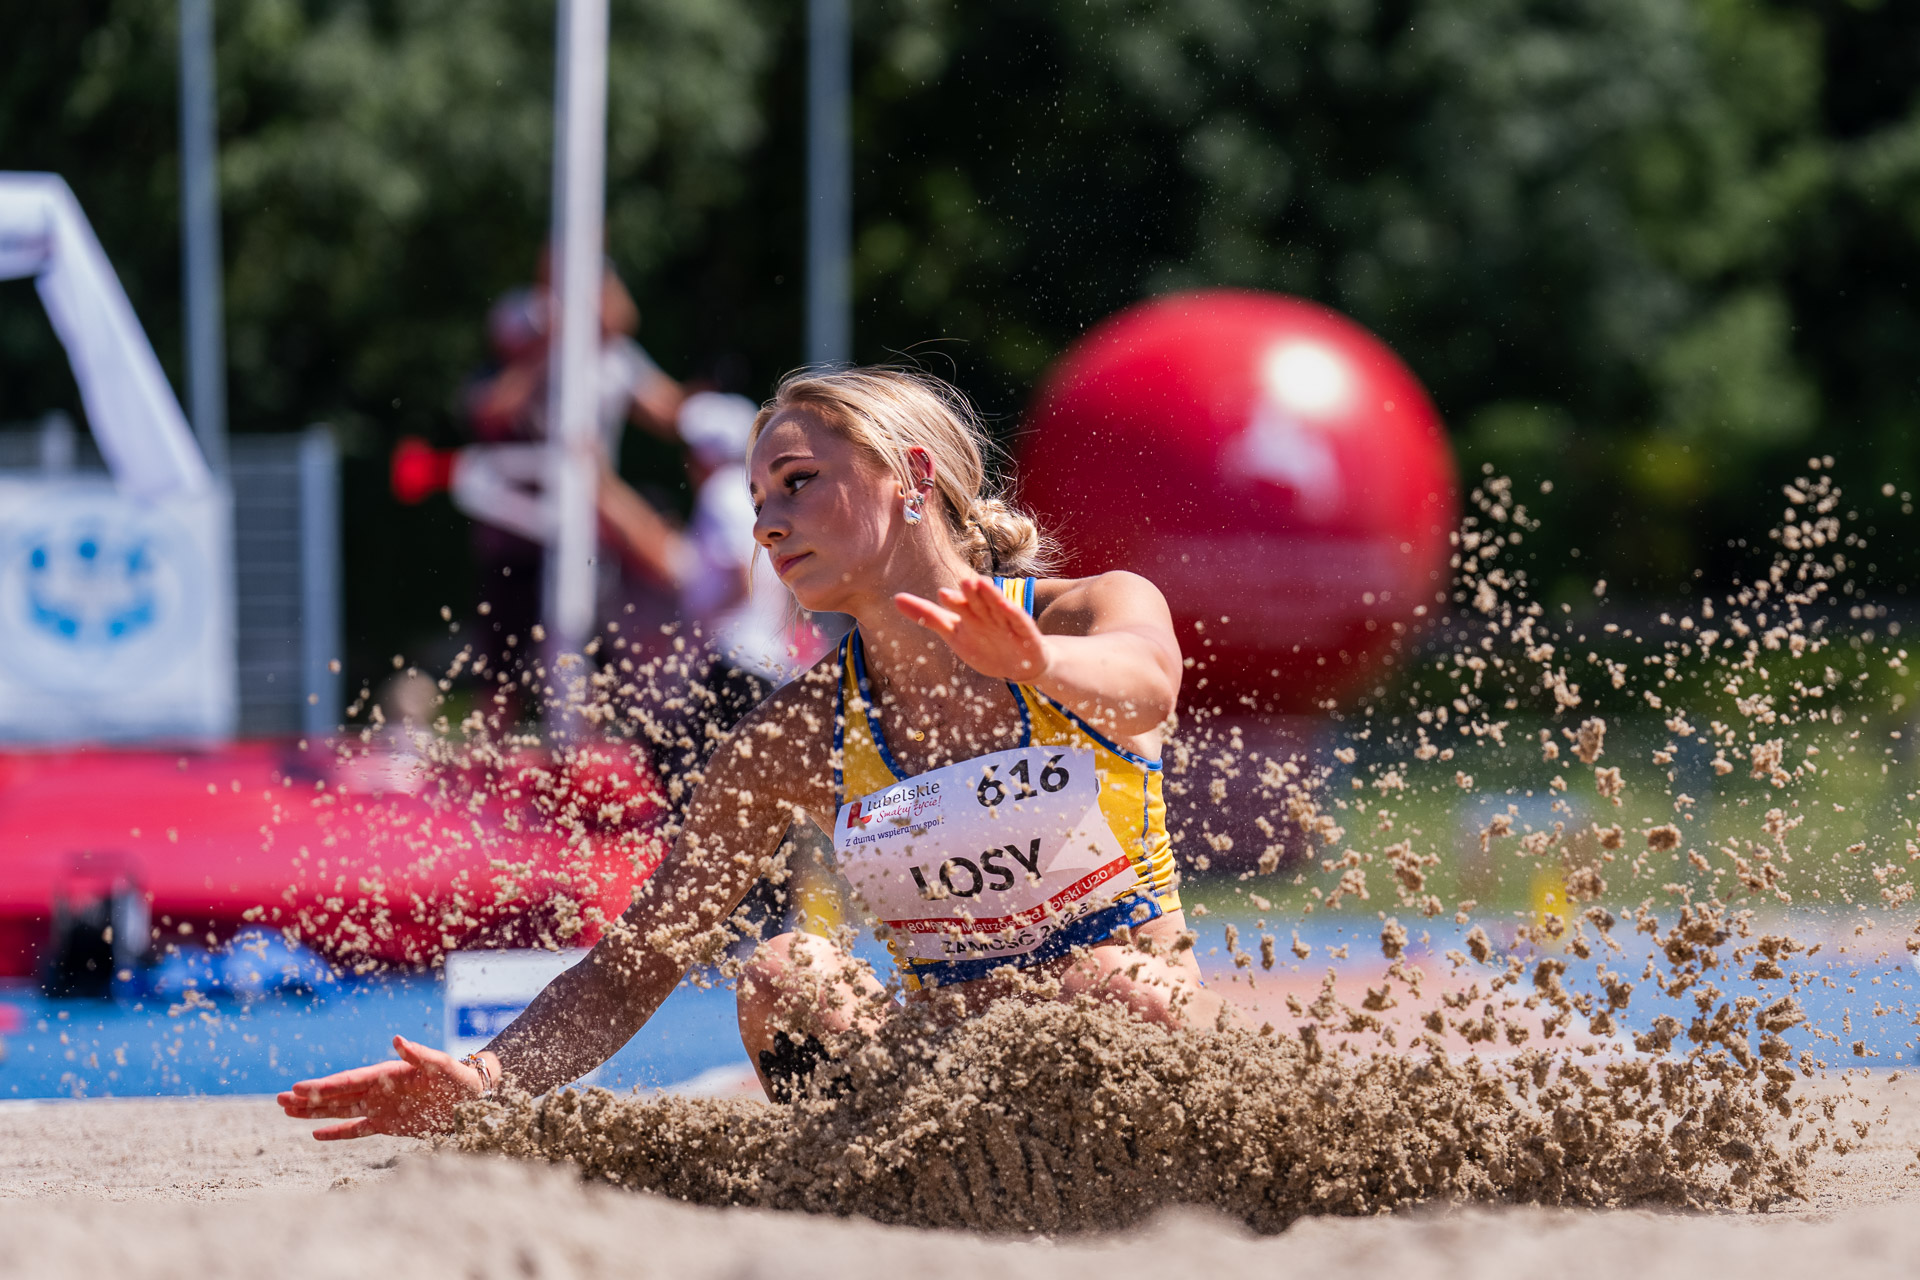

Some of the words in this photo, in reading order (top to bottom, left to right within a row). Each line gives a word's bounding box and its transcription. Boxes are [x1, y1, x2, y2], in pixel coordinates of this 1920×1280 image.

[977, 754, 1069, 807] 616
[852, 834, 876, 845] dumą
[876, 803, 912, 823] Smakuj
[909, 838, 1042, 901] LOSY
[961, 912, 1041, 932] Mistrzosta
[1045, 885, 1081, 912] olski
[1082, 869, 1108, 890] U20
